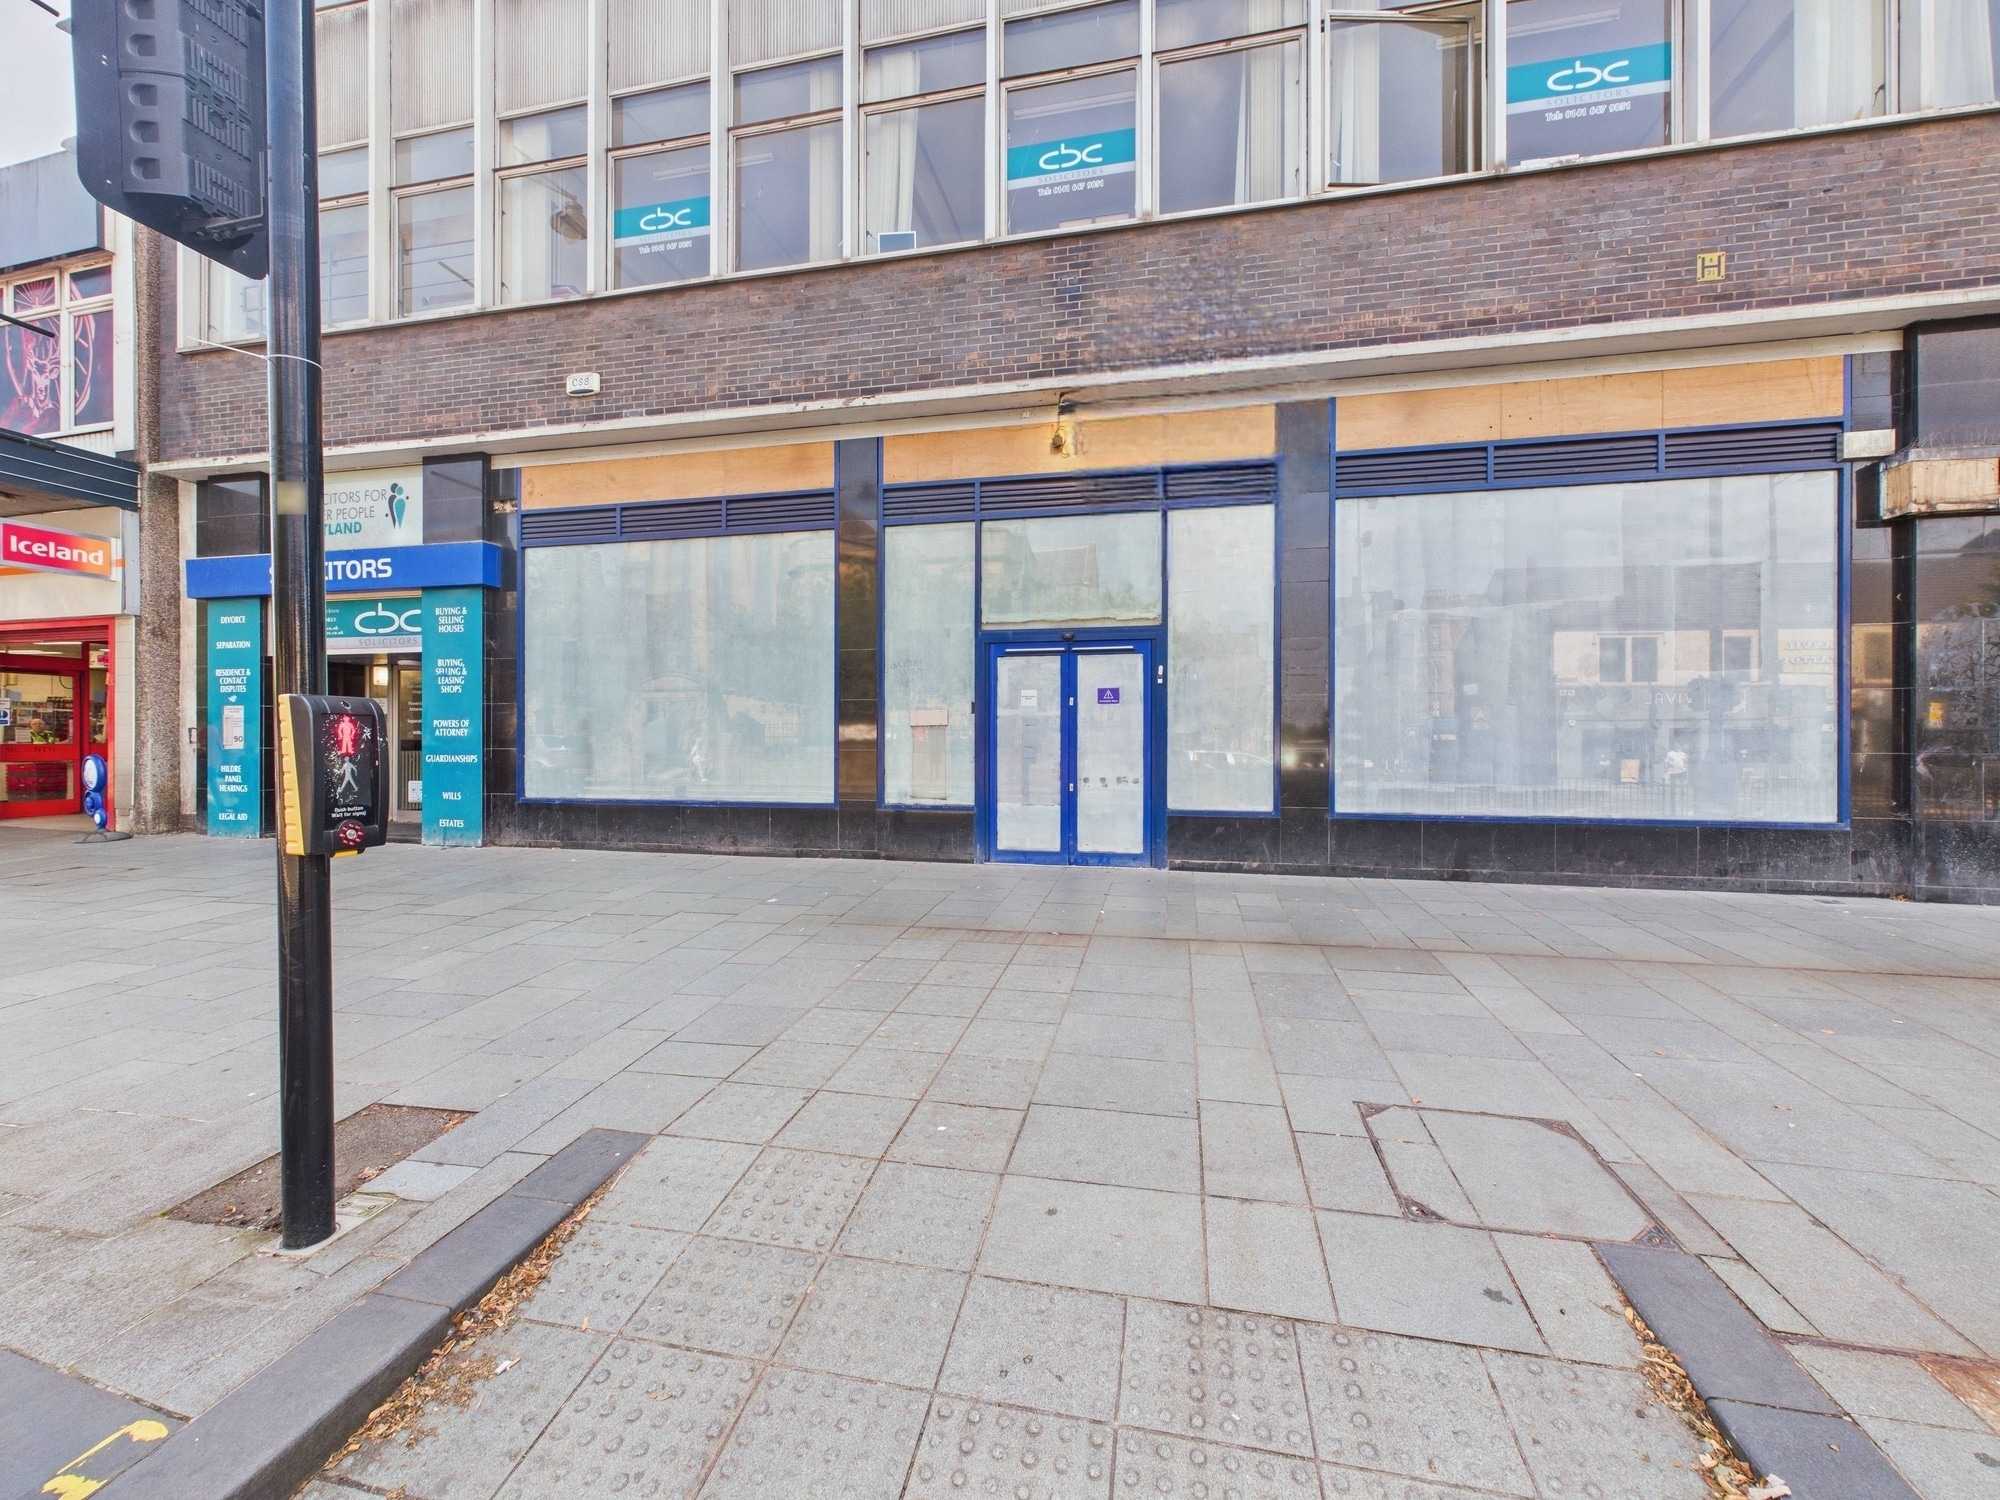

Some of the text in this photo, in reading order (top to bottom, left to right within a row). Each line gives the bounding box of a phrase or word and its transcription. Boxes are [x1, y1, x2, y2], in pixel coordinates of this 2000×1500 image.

[1547, 60, 1630, 91] cbc
[1546, 87, 1631, 107] SOLICITORS
[1565, 107, 1587, 119] 0141
[1039, 143, 1103, 169] cbc
[1039, 168, 1104, 183] SOLICITORS
[640, 207, 691, 230] cbc
[640, 231, 692, 243] SOLICITORS
[572, 377, 590, 387] CSS
[364, 489, 387, 502] FOR
[336, 506, 375, 520] PEOPLE
[325, 522, 362, 536] LAND
[10, 534, 104, 566] Iceland
[435, 607, 467, 616] BUYING &
[220, 615, 246, 624] DIVORCE
[354, 602, 422, 634] cbc
[438, 615, 464, 625] SELLING
[438, 624, 464, 633] HOUSES
[216, 641, 251, 649] SEPARATION
[359, 637, 418, 647] SOLICITORS
[437, 659, 465, 667] BUYING,
[215, 668, 251, 677] RESIDENCE &
[462, 667, 467, 676] &
[220, 677, 247, 685] CONTACT
[438, 676, 464, 685] LEASING
[220, 685, 247, 693] DISPUTES
[440, 685, 462, 694] SHOPS
[433, 719, 470, 728] POWERS OF
[434, 728, 469, 736] ATTORNEY
[425, 754, 478, 763] GUARDIANSHIPS
[224, 775, 242, 783] PANEL
[219, 784, 248, 793] HEARINGS
[442, 791, 461, 800] WILLS
[219, 812, 248, 820] LEGAL AID
[439, 819, 464, 828] ESTATES
